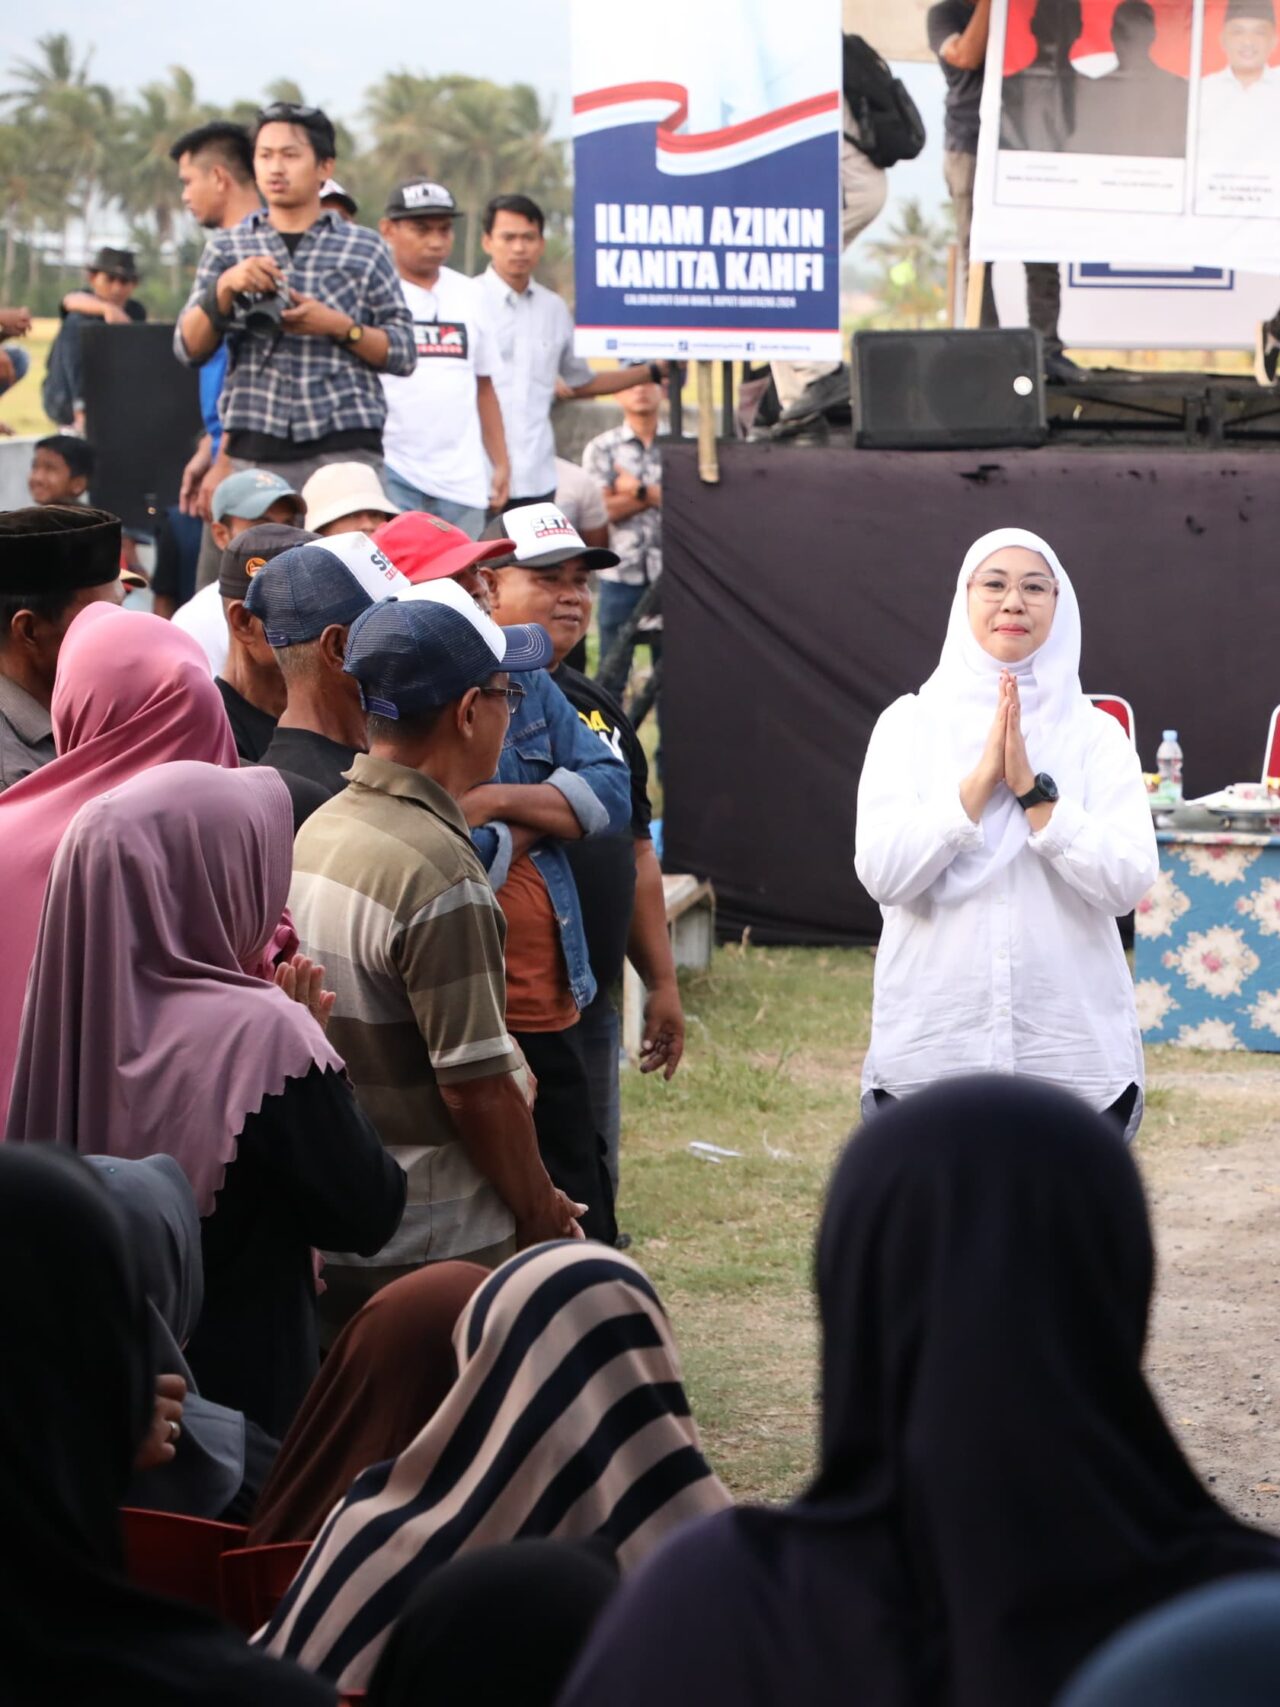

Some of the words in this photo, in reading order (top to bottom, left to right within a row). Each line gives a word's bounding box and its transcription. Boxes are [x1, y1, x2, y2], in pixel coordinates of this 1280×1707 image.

[595, 203, 704, 245] ILHAM
[709, 206, 825, 248] AZIKIN
[595, 249, 720, 290] KANITA
[725, 252, 825, 292] KAHFI
